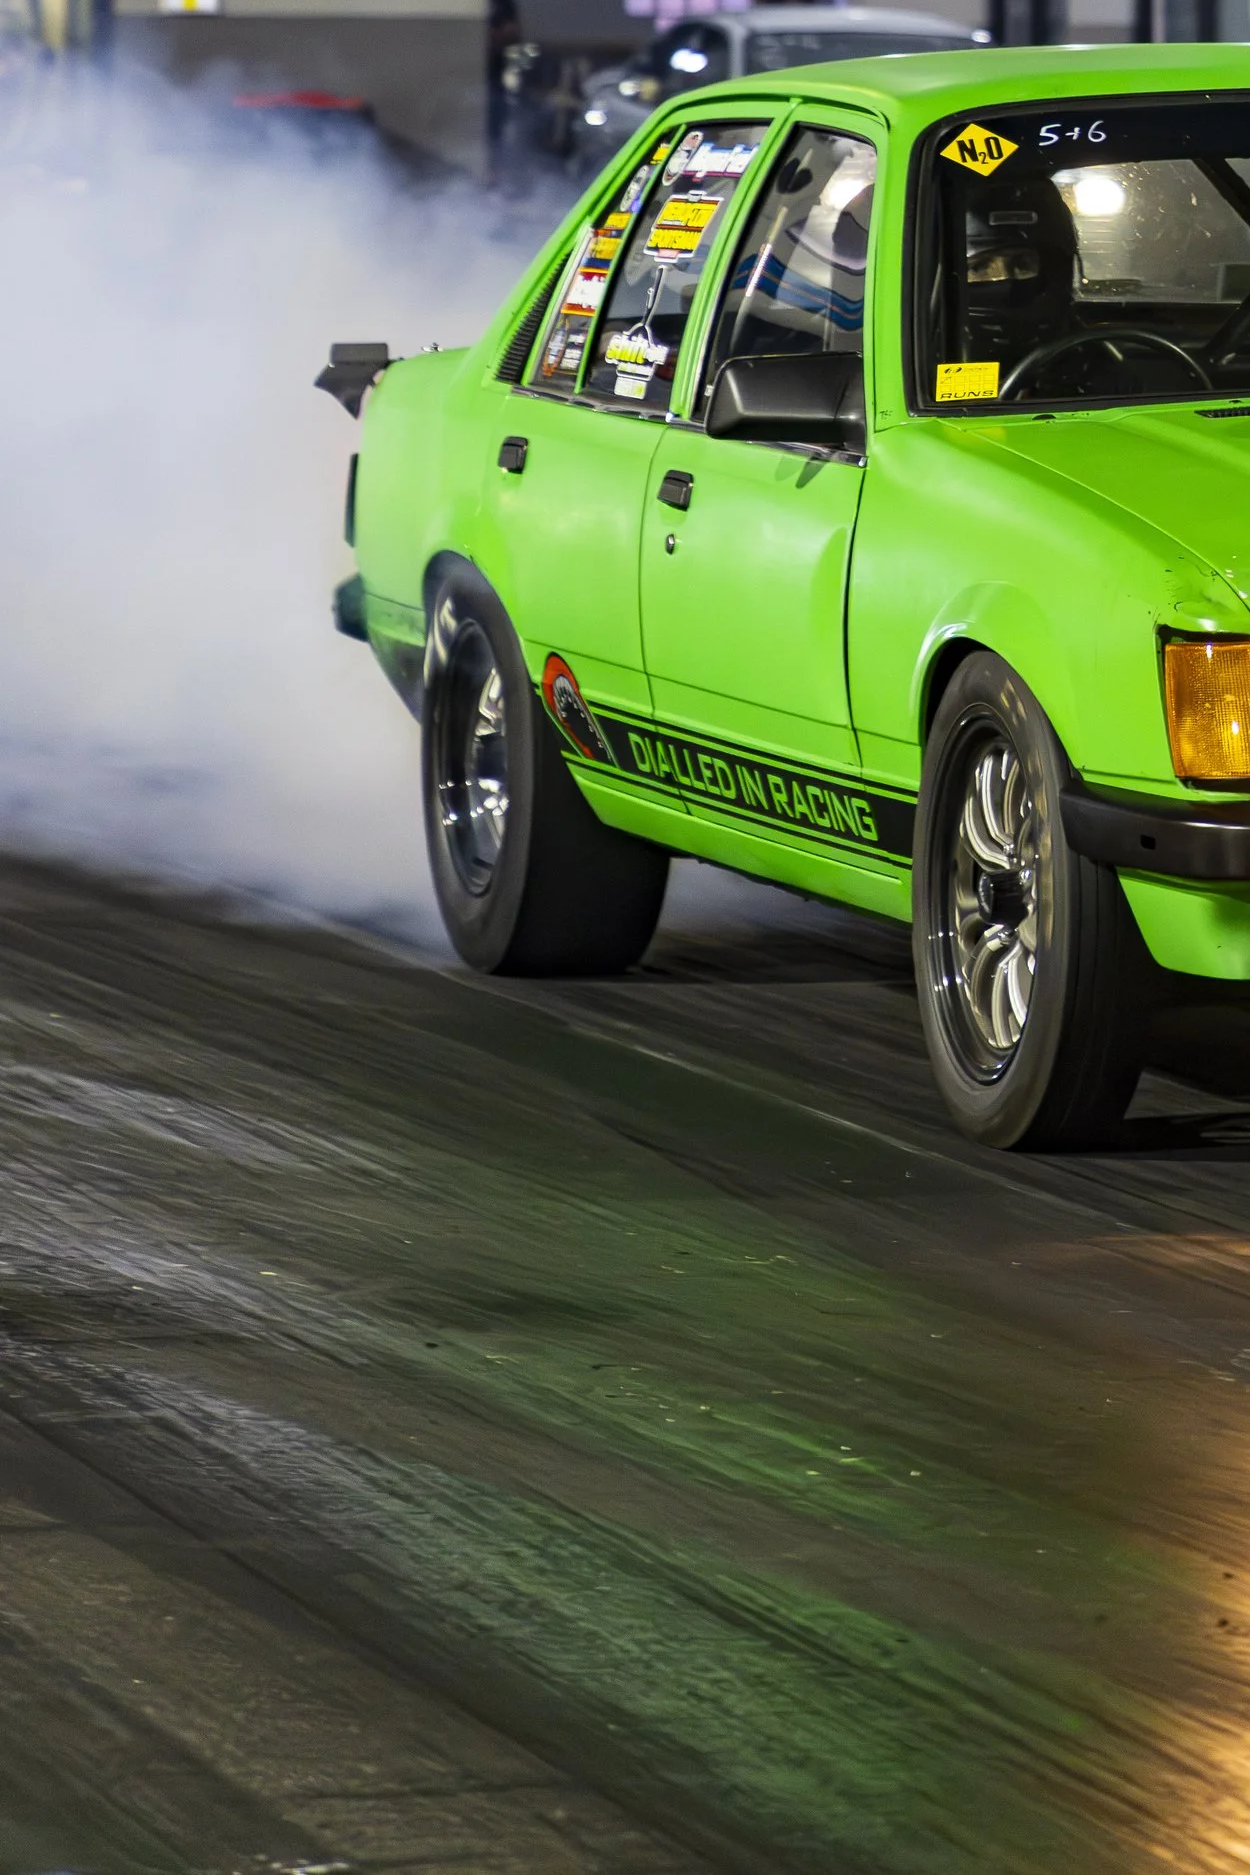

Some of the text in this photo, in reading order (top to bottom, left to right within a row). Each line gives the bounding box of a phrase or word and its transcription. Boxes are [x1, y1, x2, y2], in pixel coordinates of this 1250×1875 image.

[940, 389, 994, 399] RUNS
[627, 731, 880, 842] DIALLED IN RACING
